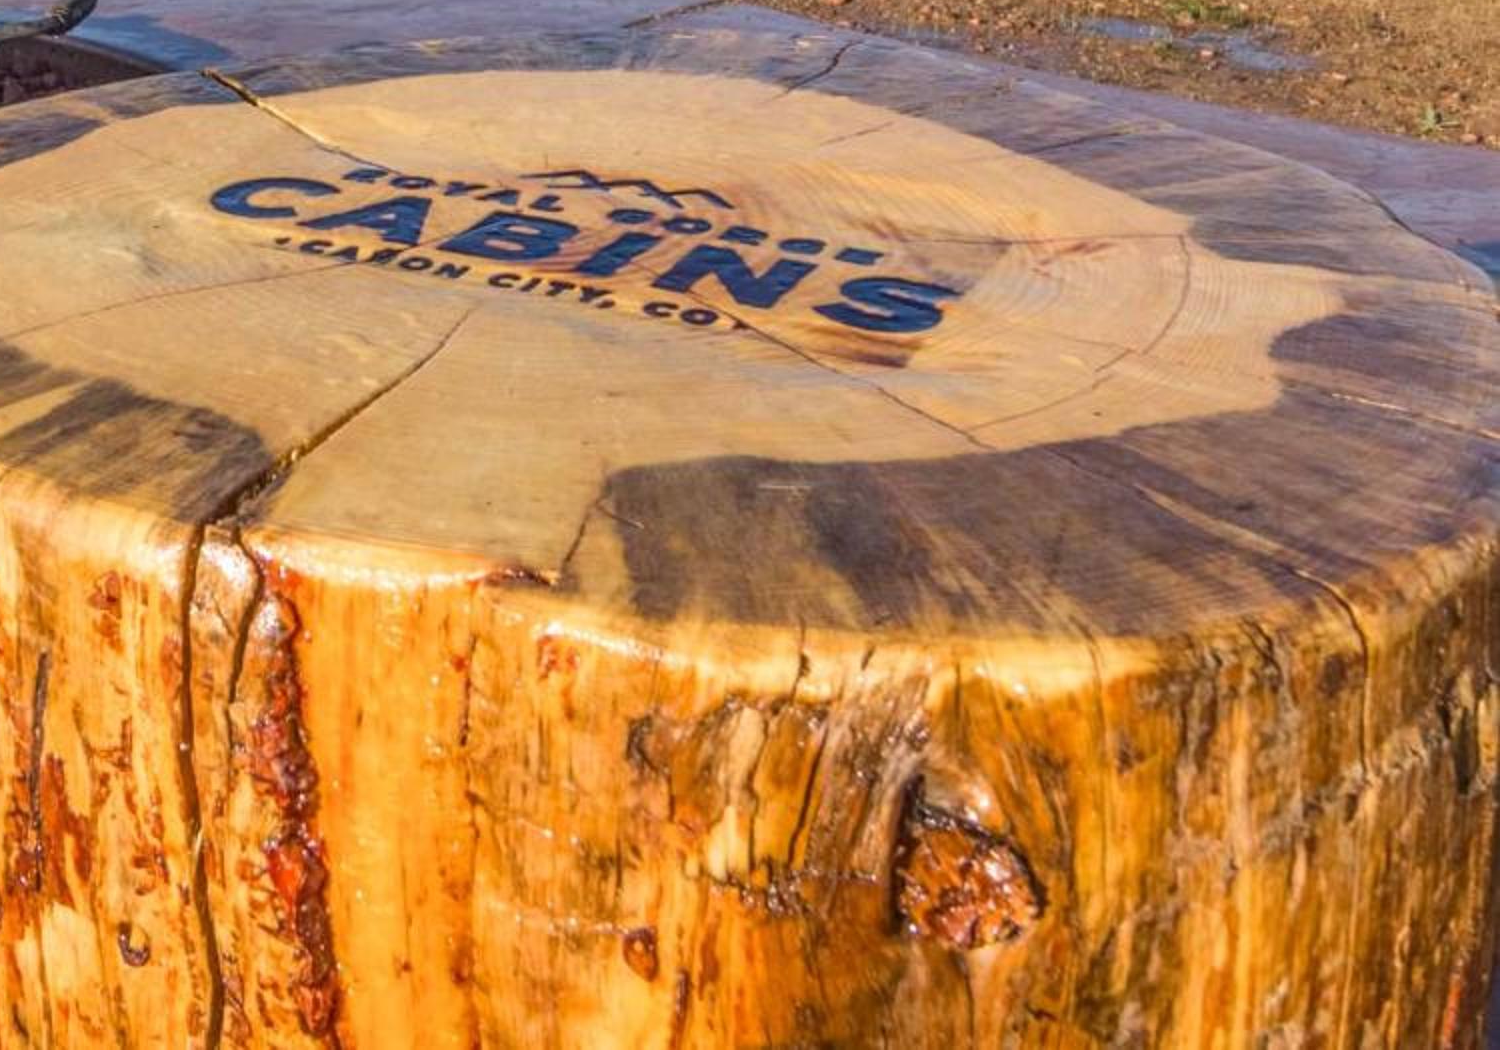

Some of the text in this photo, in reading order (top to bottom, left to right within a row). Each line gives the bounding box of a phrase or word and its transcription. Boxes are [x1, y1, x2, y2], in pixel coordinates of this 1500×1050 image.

[342, 168, 565, 213] ROYAL
[210, 177, 964, 333] CABINS
[642, 301, 720, 326] CO
